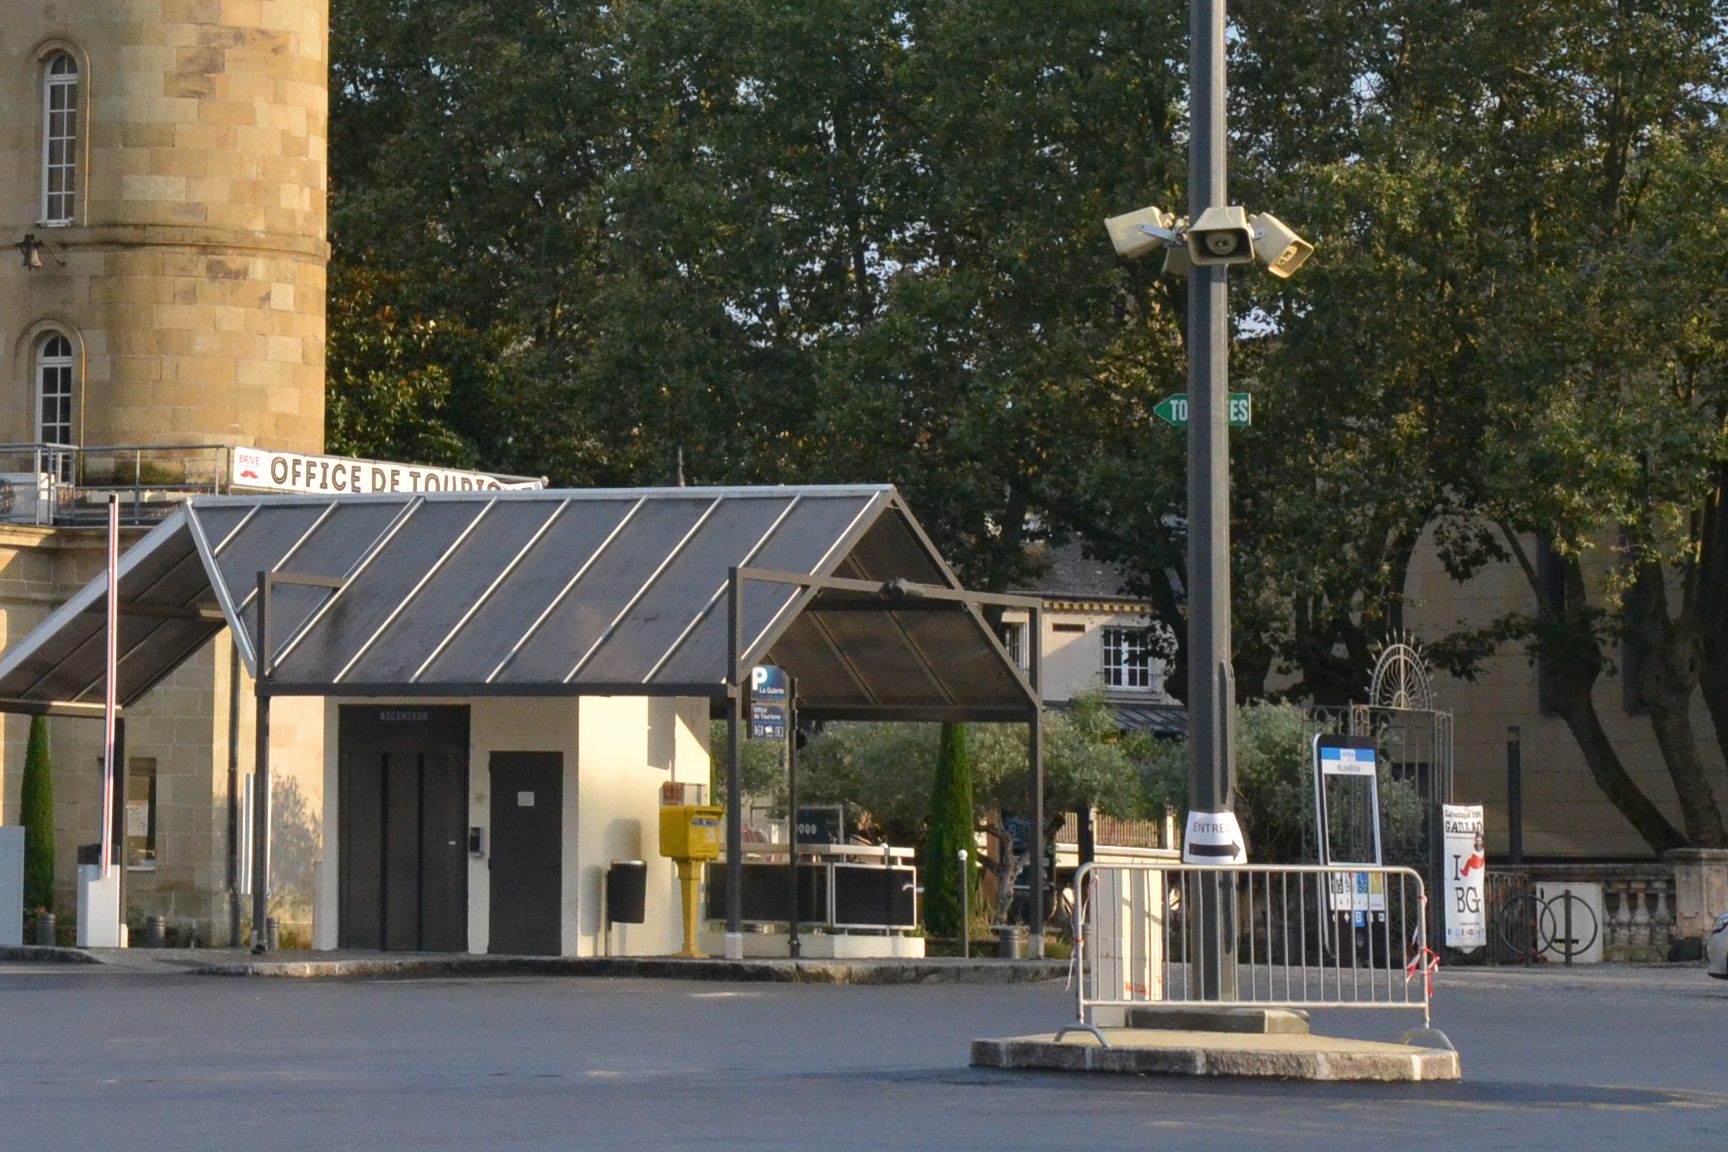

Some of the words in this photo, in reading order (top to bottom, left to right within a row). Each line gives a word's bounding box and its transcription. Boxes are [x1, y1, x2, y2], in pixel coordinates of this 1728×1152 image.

[271, 456, 361, 493] OFFICE
[373, 467, 401, 493] DE
[409, 470, 533, 492] TOURI
[752, 666, 768, 691] P
[380, 711, 429, 721] ASCENSEUR
[1453, 854, 1461, 881] I
[1455, 886, 1481, 913] BG
